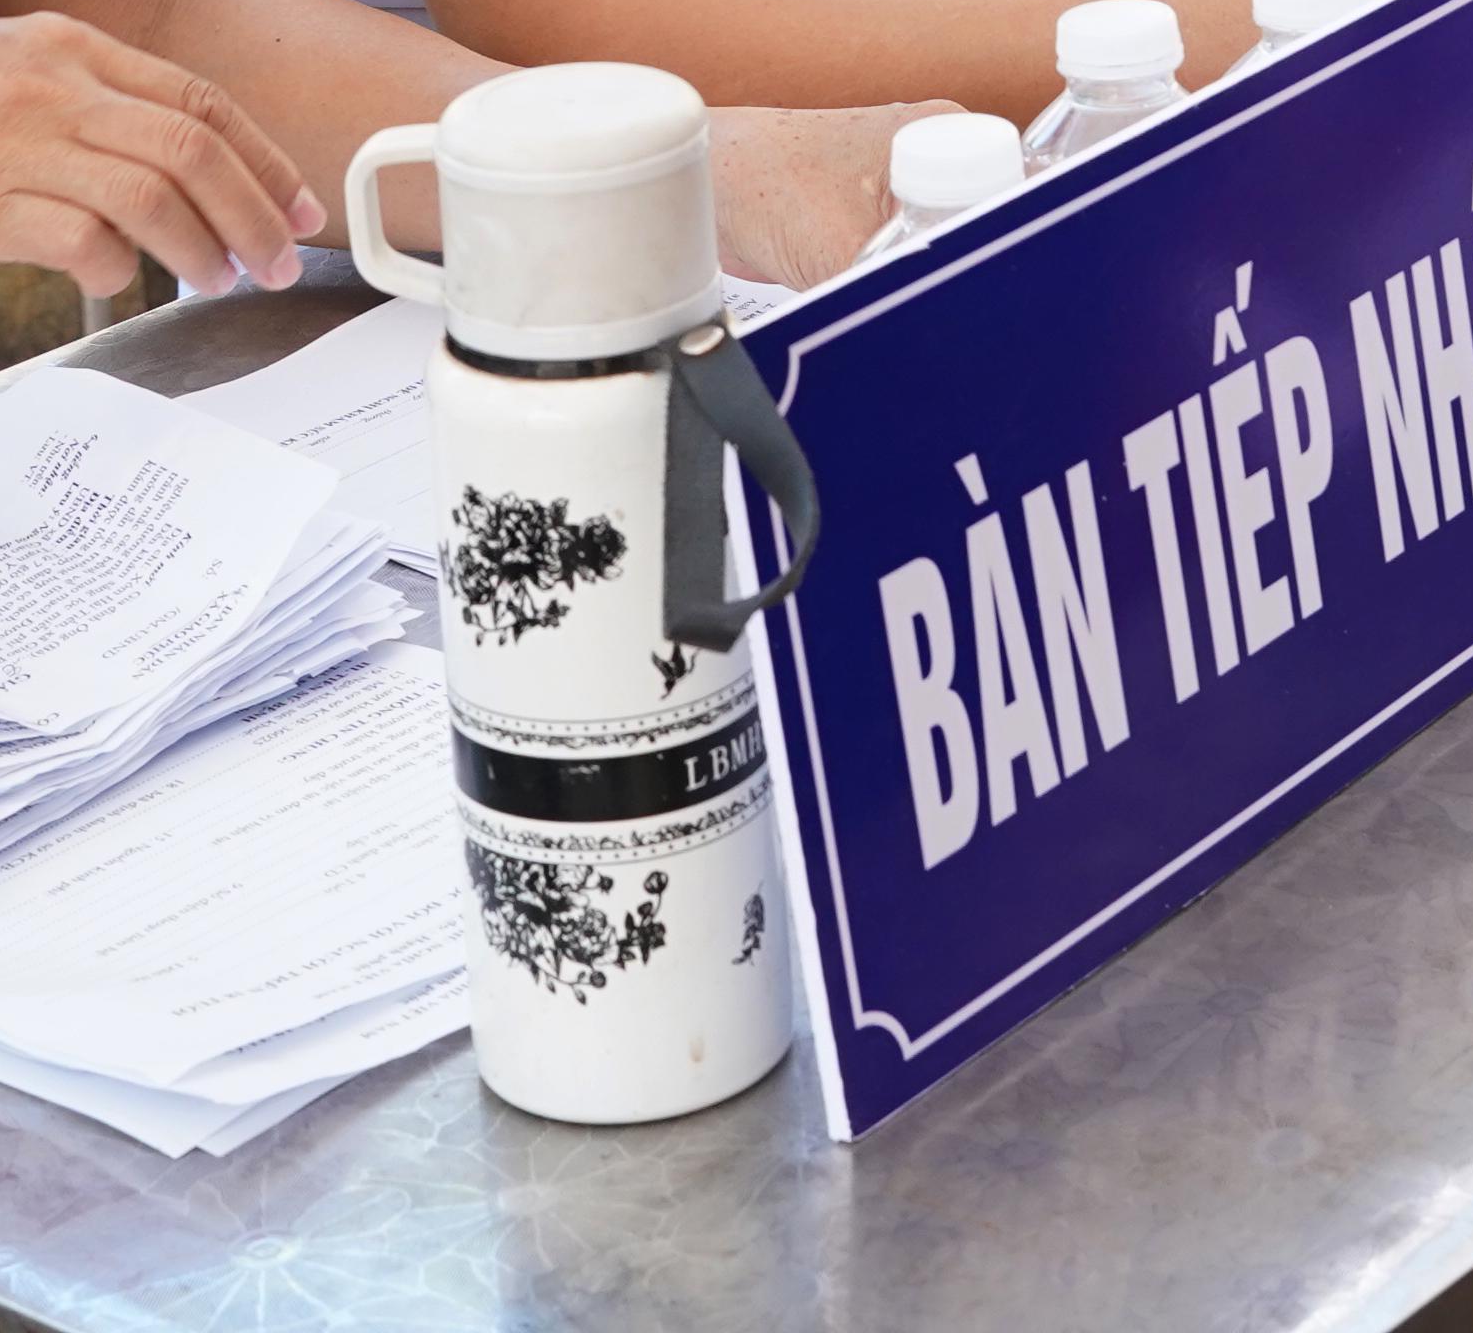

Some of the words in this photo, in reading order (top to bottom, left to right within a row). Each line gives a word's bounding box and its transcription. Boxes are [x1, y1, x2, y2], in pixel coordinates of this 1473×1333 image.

[124, 457, 158, 495] khám
[148, 474, 192, 522] nghiệm
[53, 484, 93, 530] UBND
[164, 530, 193, 562] Kính
[878, 454, 1131, 871] BÀN
[1124, 260, 1334, 703] TIẾP
